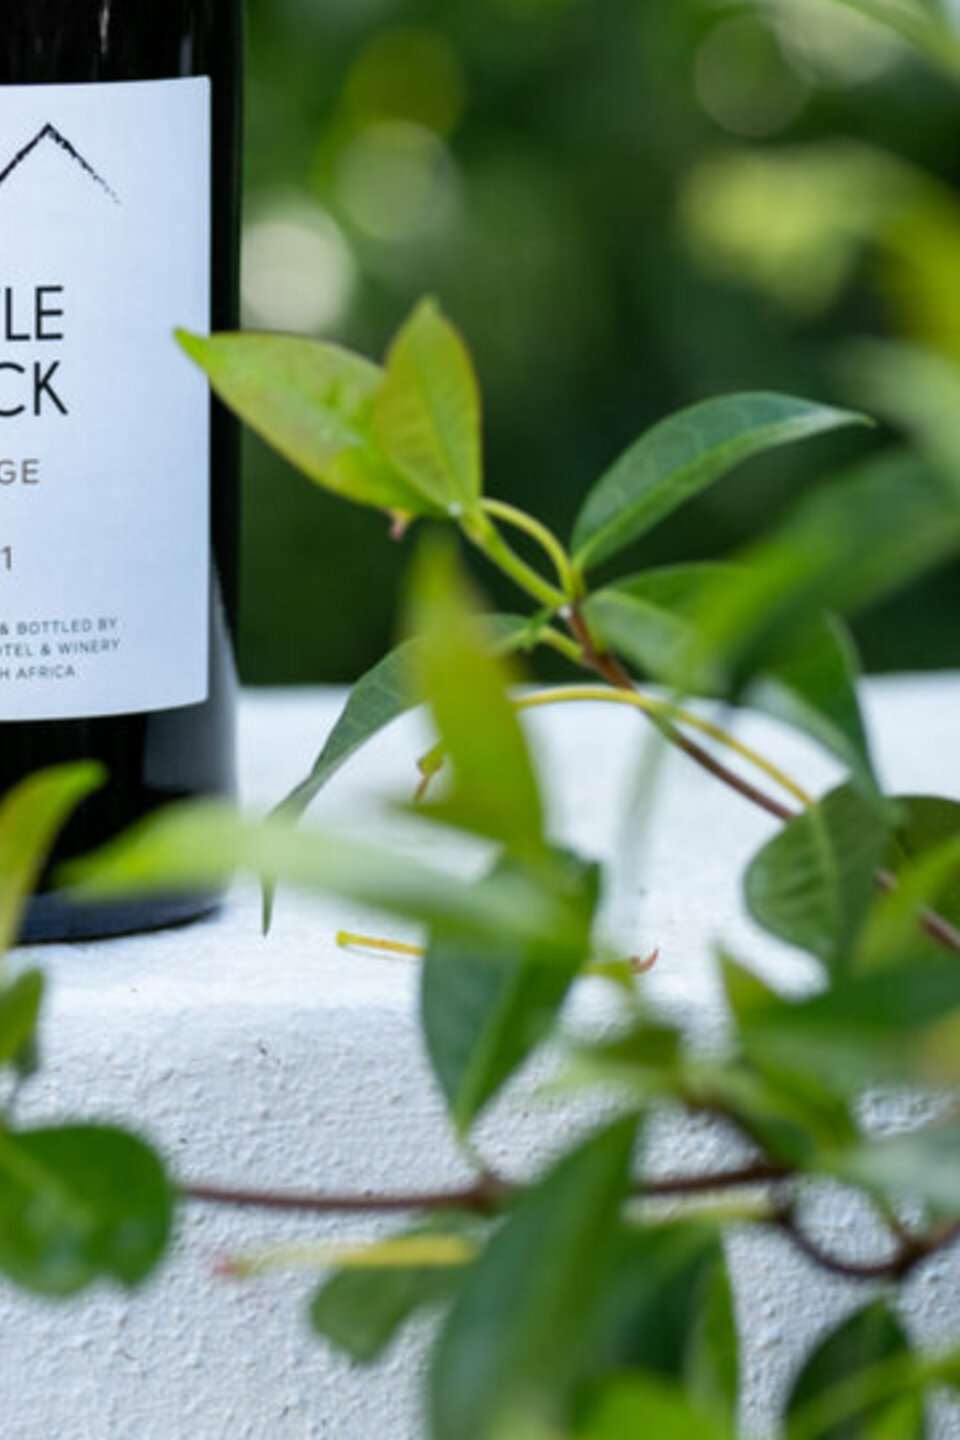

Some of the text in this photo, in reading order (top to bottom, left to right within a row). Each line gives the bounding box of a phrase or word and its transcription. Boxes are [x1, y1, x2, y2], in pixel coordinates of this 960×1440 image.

[16, 617, 93, 636] BOTTLED
[97, 617, 117, 632] BY
[39, 642, 52, 657] &
[57, 638, 121, 655] WINERY
[15, 664, 76, 680] AFRICA
